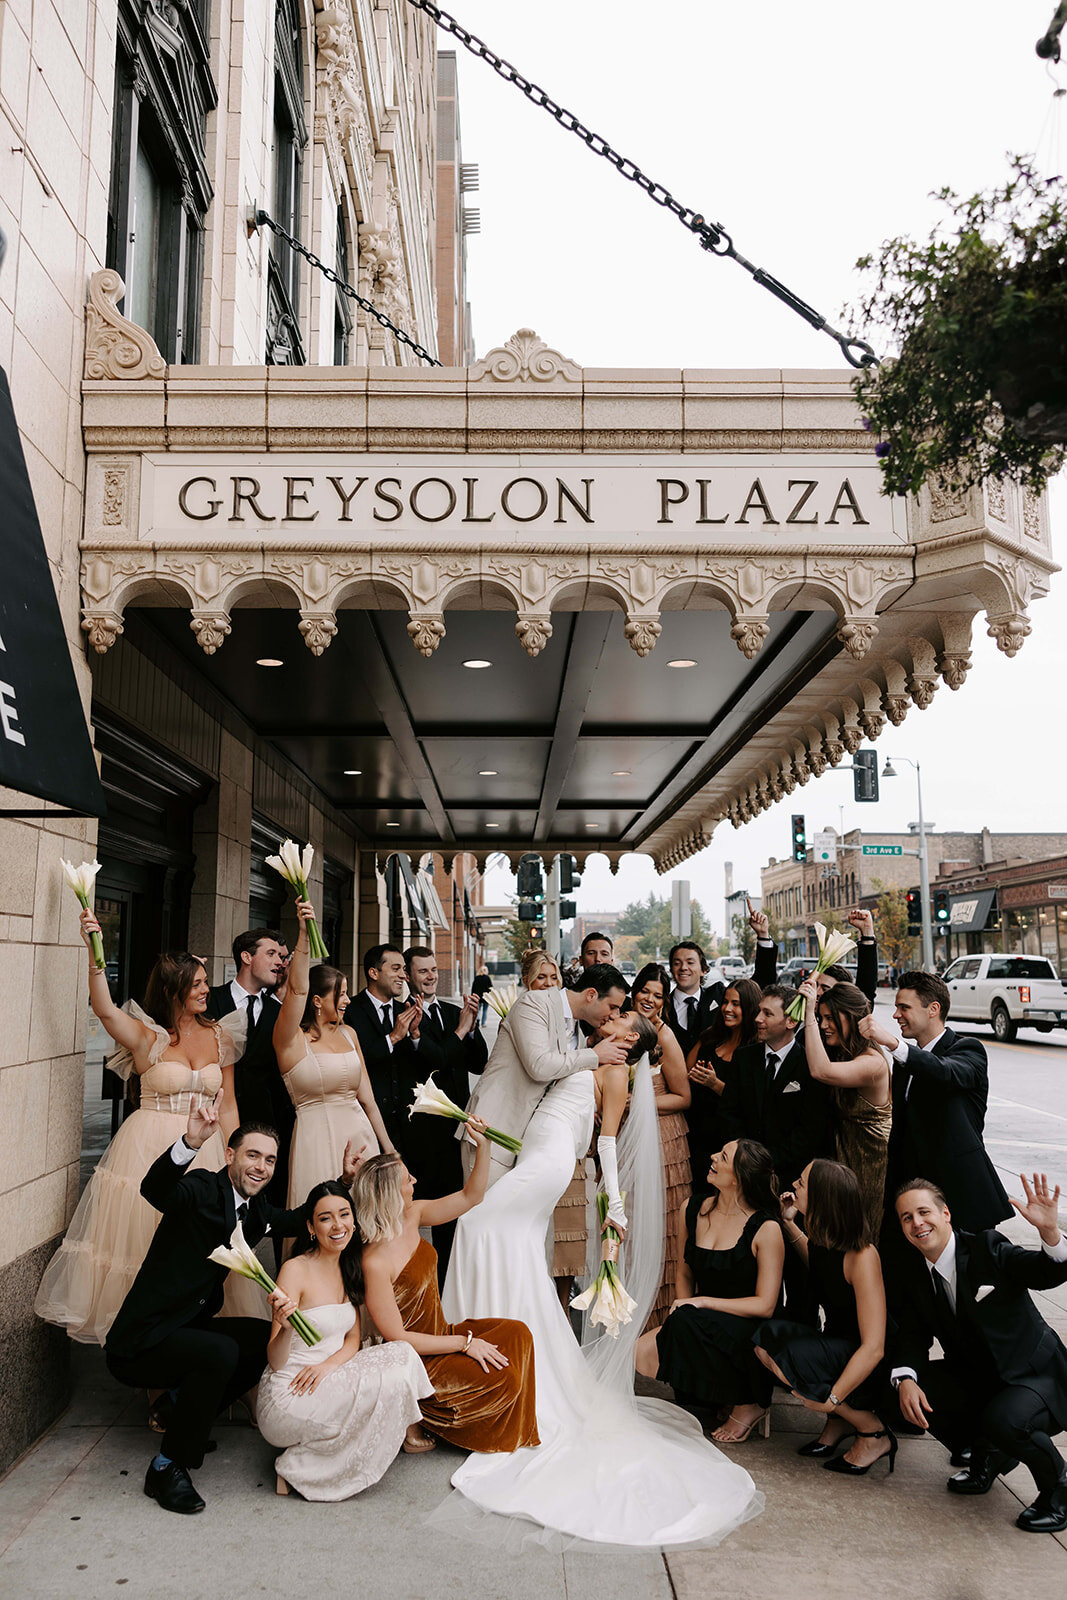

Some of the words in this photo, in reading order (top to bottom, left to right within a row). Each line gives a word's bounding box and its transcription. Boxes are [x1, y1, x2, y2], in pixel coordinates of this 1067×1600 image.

[178, 475, 595, 524] GREYSOLON
[656, 477, 870, 525] PLAZA
[865, 846, 878, 854] 3rd
[879, 846, 893, 854] Ave
[894, 846, 900, 854] E
